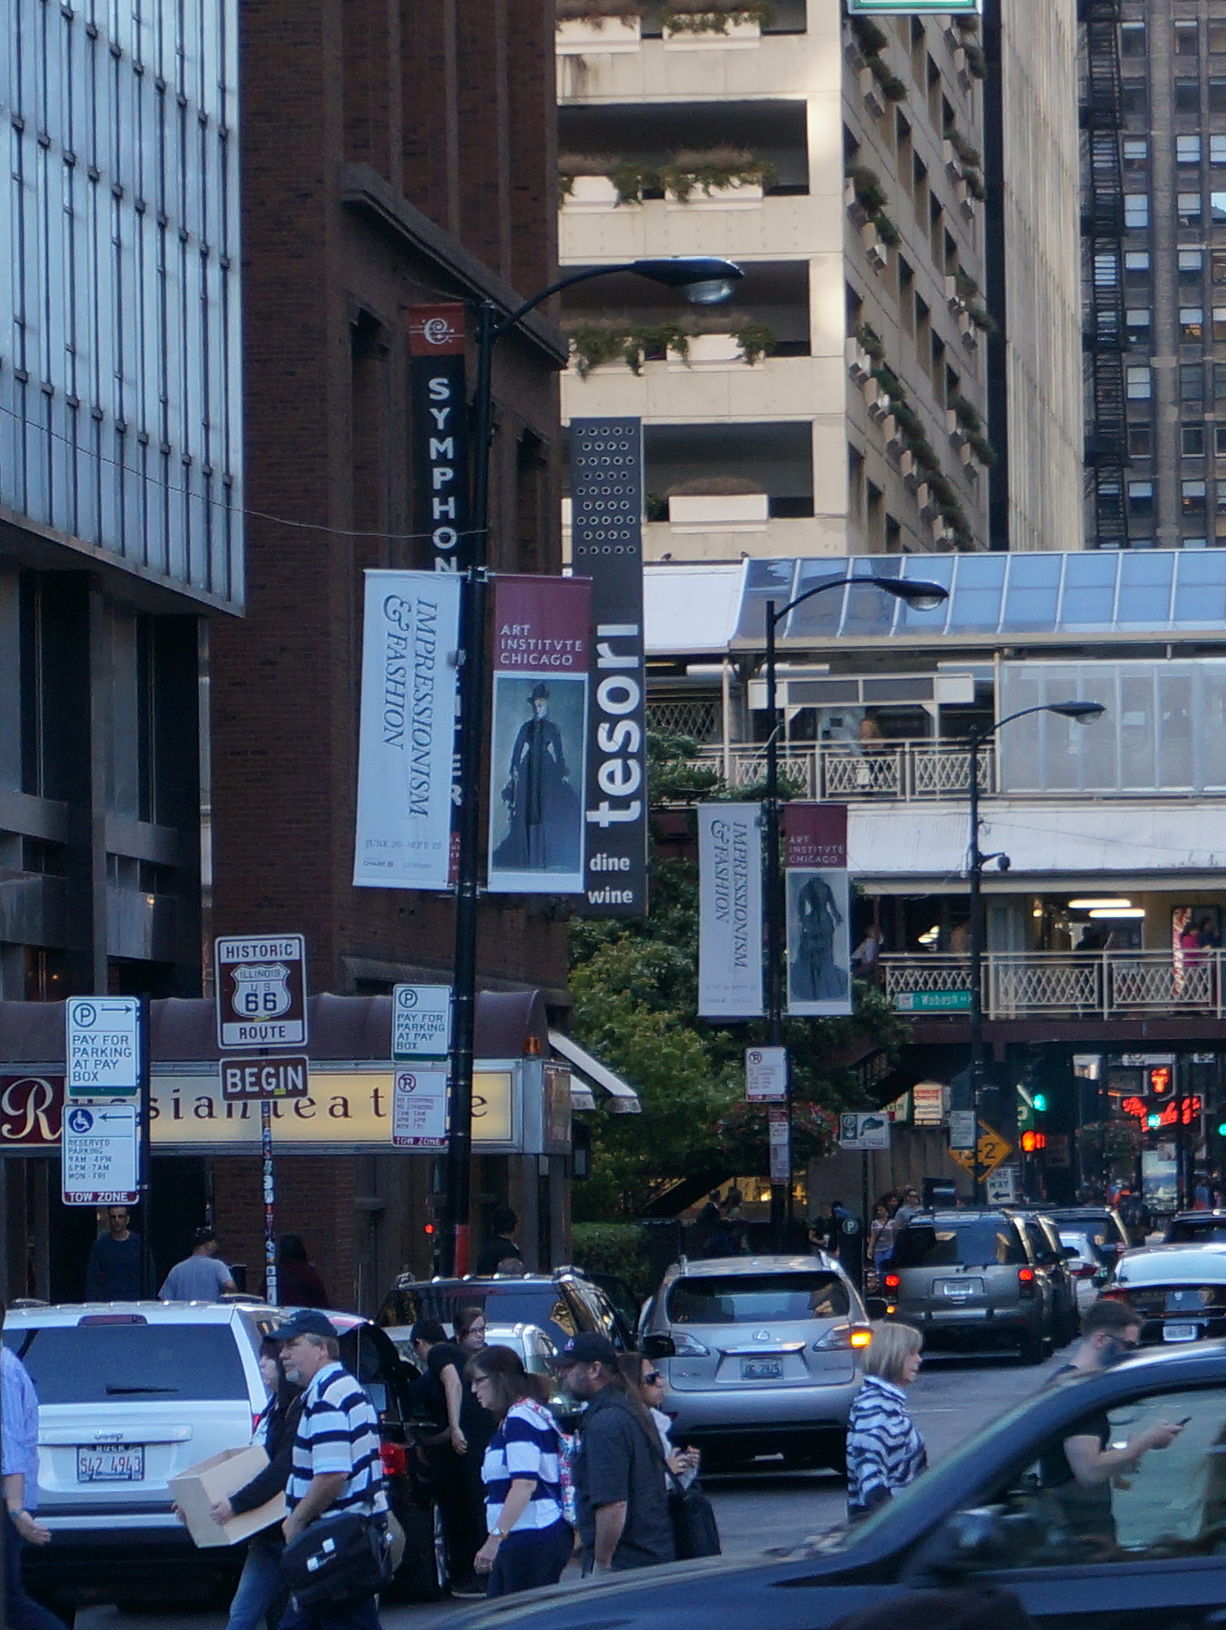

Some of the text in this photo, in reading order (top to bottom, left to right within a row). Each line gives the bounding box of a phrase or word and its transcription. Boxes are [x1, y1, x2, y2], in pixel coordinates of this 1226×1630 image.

[500, 624, 531, 636] ART
[500, 653, 573, 666] CHICAGO
[383, 594, 412, 750] & FASHION
[408, 597, 438, 817] IMPRESSIONISM
[589, 853, 630, 871] dine
[789, 855, 838, 864] CHICAGO
[714, 844, 730, 923] FASHION
[587, 889, 633, 904] wine
[732, 821, 748, 969] IMPRESSIONISM
[226, 943, 294, 960] HISTORIC
[240, 968, 281, 979] ILLINOIS
[244, 992, 277, 1012] 66
[397, 1013, 444, 1023] PAY FOR
[239, 1025, 286, 1040] ROUTE
[397, 1023, 445, 1033] PARKING
[72, 1035, 129, 1046] PAY FOR
[397, 1033, 434, 1042] AT PAY
[396, 1042, 418, 1050] BOX
[72, 1047, 132, 1058] PARKING
[73, 1060, 119, 1070] AT PAY
[72, 1071, 99, 1082] BOX
[226, 1066, 304, 1094] BEGIN
[2, 1077, 250, 1141] Rsian
[370, 1086, 488, 1118] te
[68, 1139, 110, 1147] RESERVED
[69, 1192, 128, 1201] TOW ZONE
